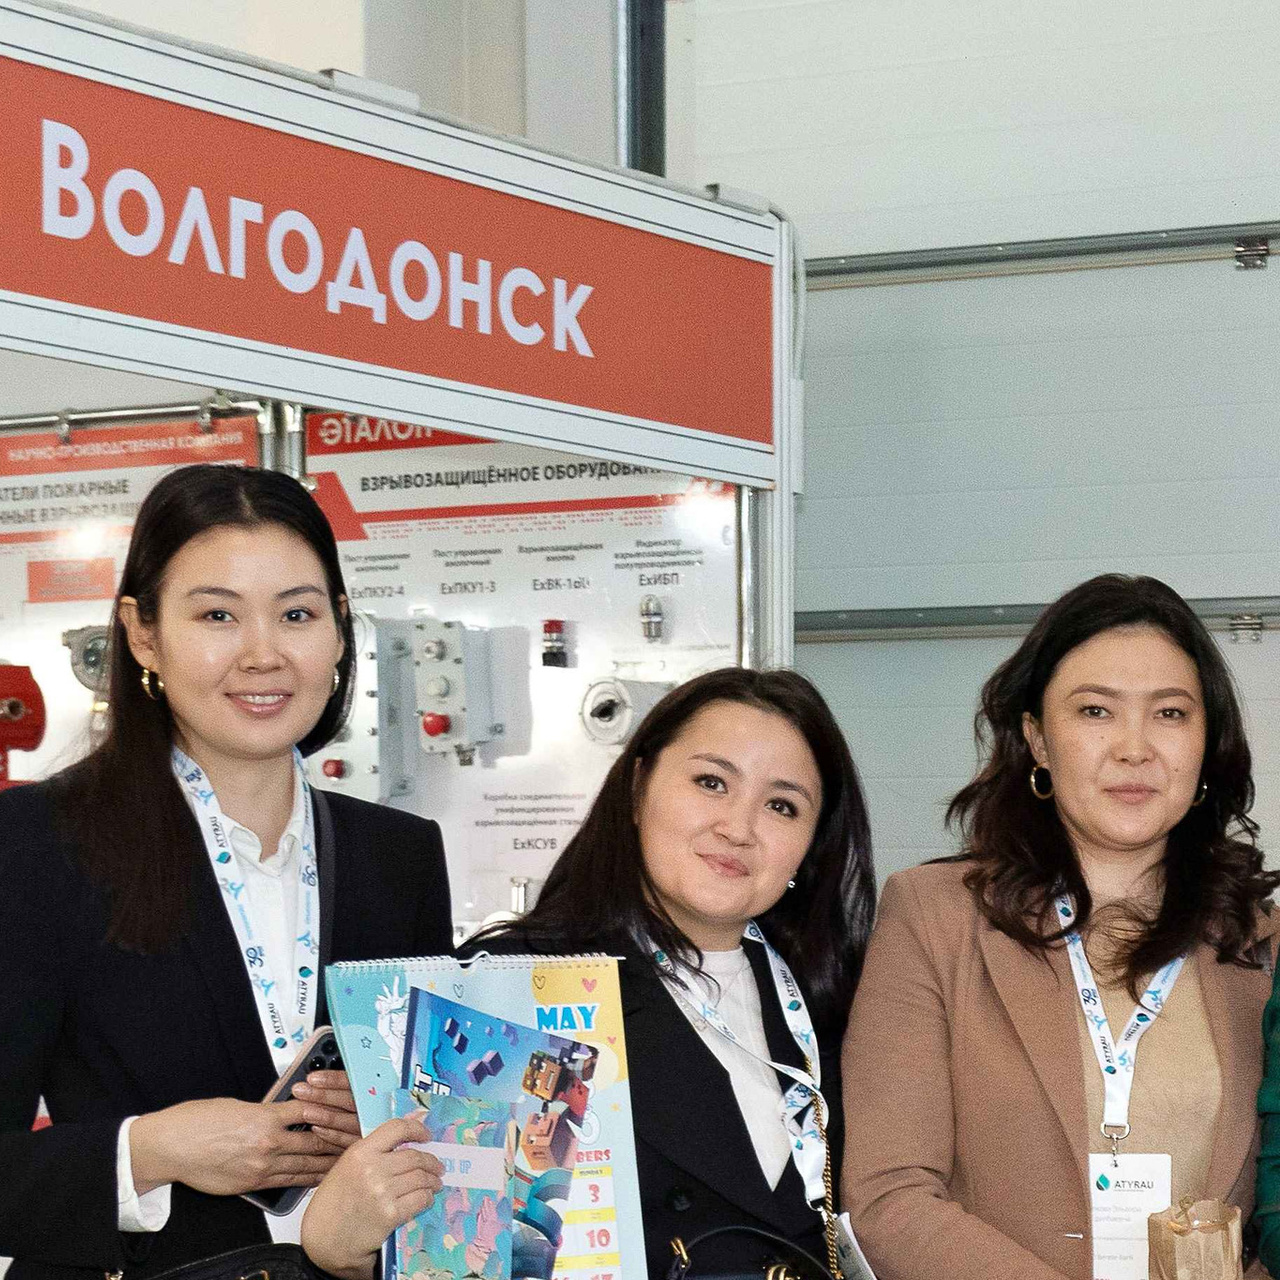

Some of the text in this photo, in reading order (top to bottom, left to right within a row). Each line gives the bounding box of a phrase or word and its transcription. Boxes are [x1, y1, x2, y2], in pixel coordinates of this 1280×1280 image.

[40, 118, 596, 359] ВОЛГОДОНСК
[535, 1004, 600, 1031] MAY
[588, 1183, 600, 1203] 3
[1114, 1180, 1154, 1189] ATYRAU
[586, 1228, 611, 1249] 10
